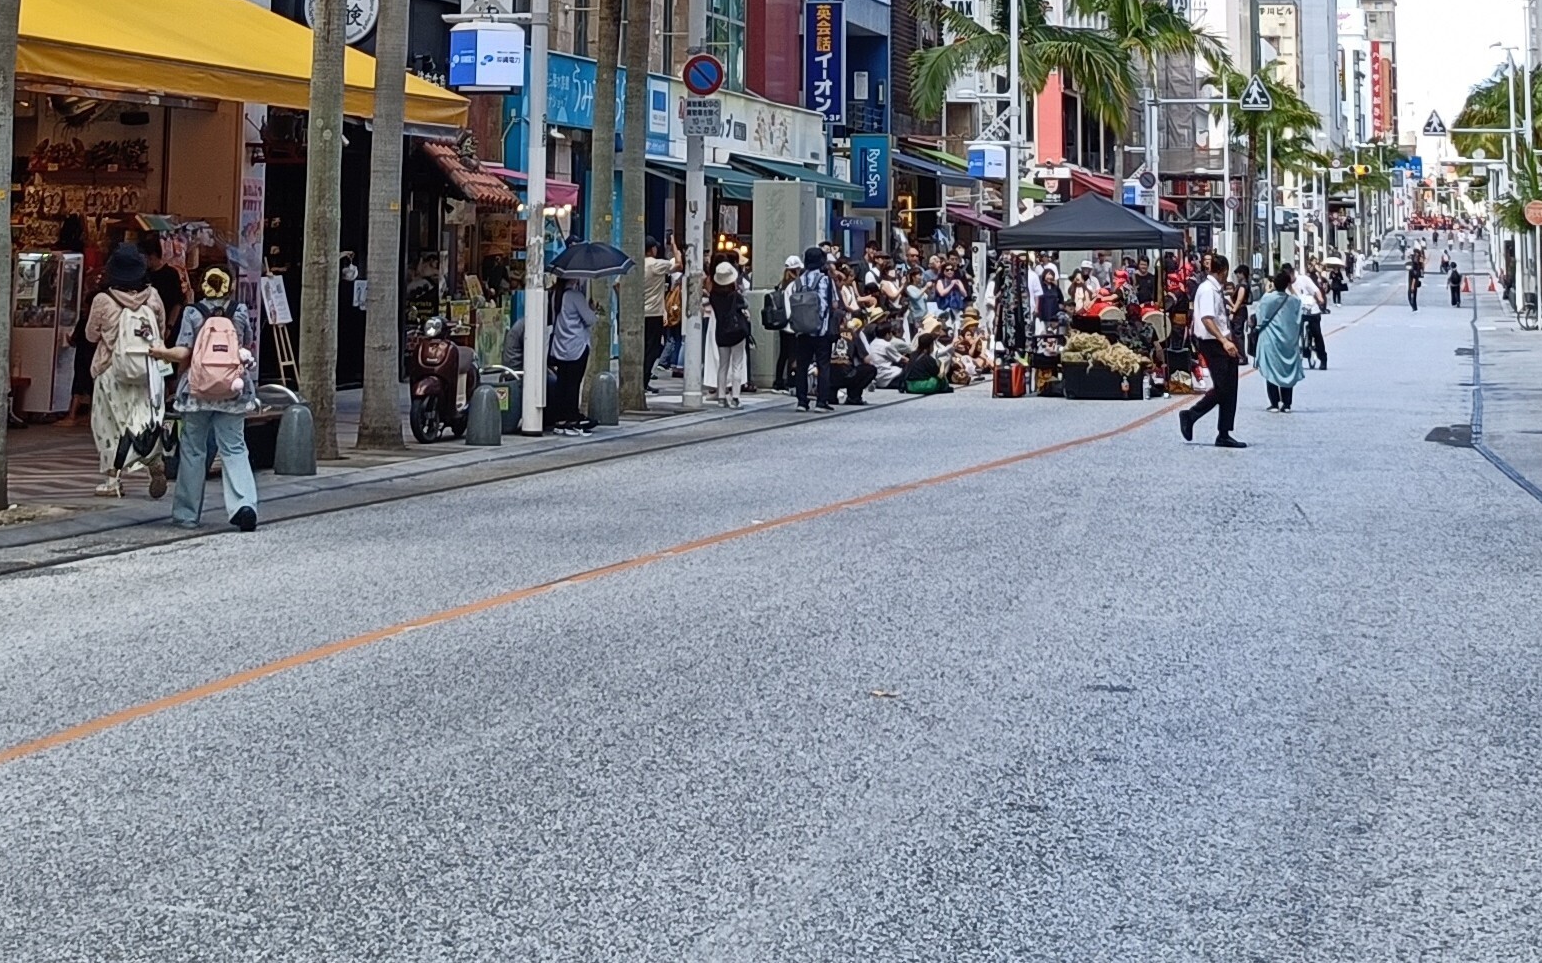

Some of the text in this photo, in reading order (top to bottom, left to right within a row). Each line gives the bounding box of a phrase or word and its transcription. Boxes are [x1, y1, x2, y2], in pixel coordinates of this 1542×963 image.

[816, 4, 832, 52] 英会話
[814, 52, 834, 112] イーオン
[867, 148, 880, 172] Ryu
[866, 174, 880, 197] Spa
